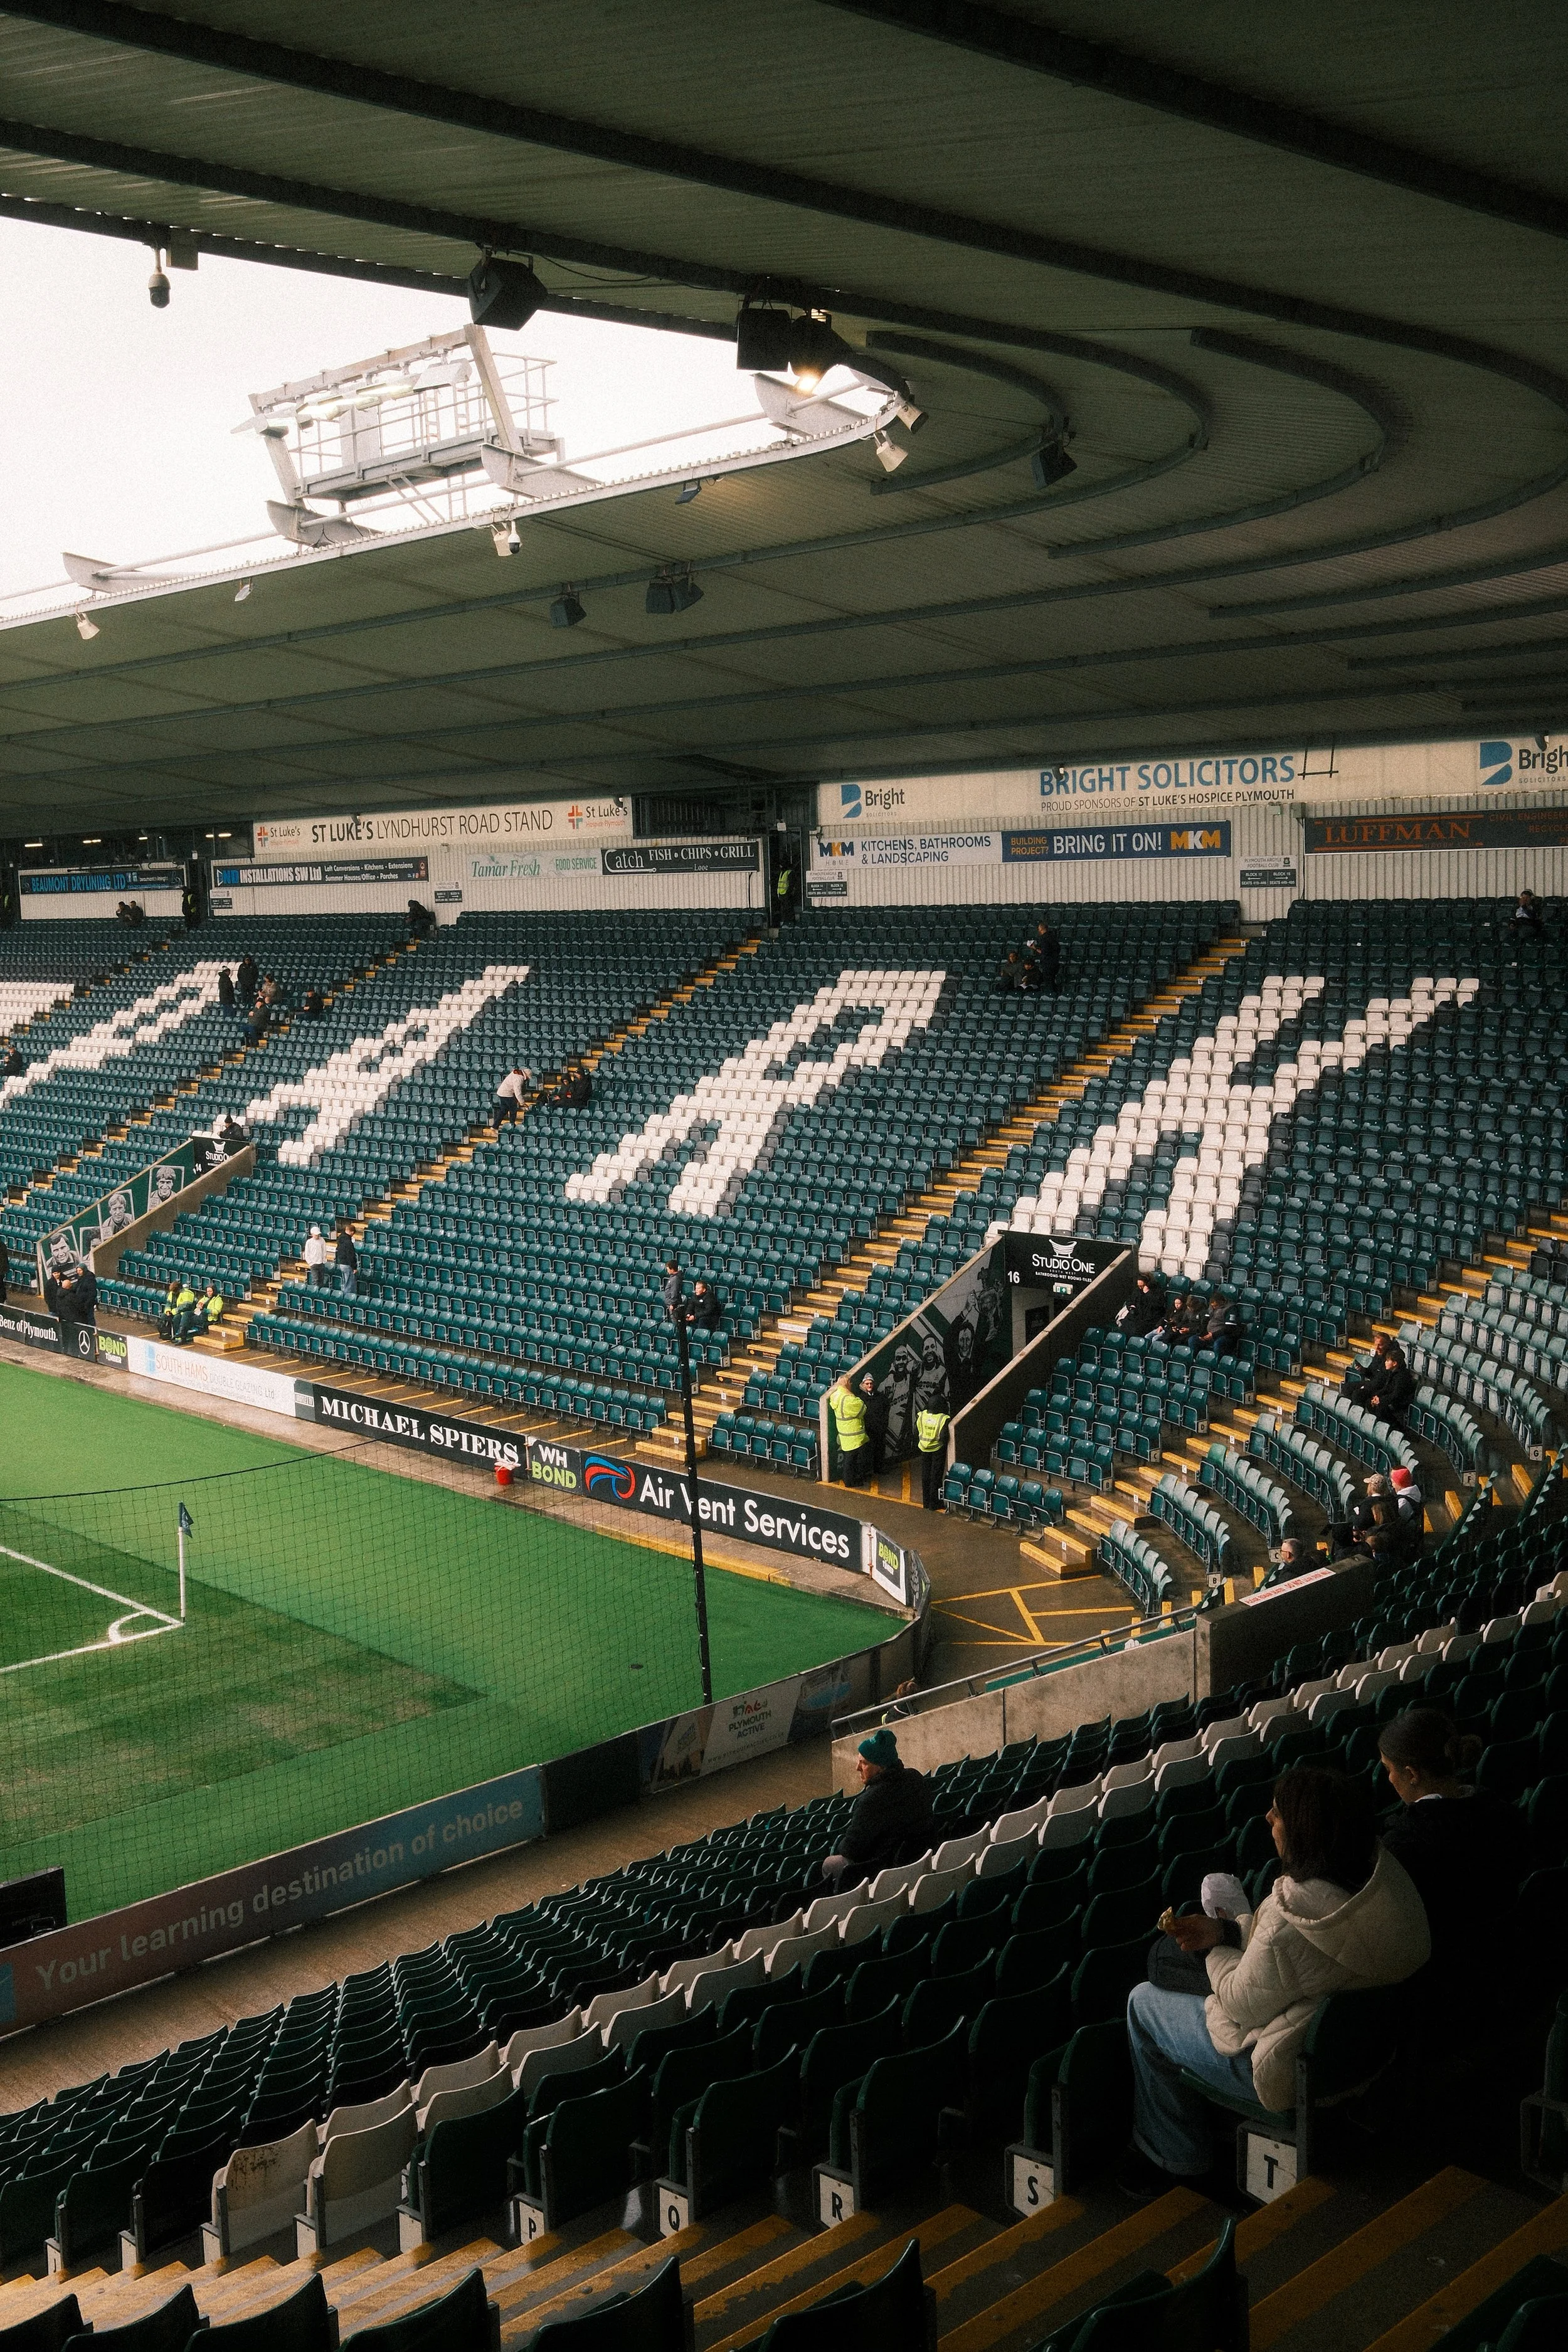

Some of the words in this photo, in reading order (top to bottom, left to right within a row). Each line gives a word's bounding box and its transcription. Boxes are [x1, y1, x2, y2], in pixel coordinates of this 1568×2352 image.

[1040, 766, 1130, 796] BRIGHT
[1138, 755, 1295, 790] SOLICITORS
[866, 788, 905, 810] Bright
[1041, 800, 1072, 812] PROUD
[1074, 797, 1121, 810] SPONSORS
[1123, 797, 1136, 807] OF
[1138, 797, 1150, 807] ST
[1152, 794, 1186, 806] LUKE'S
[1189, 791, 1233, 804] HOSPICE
[1235, 789, 1295, 802] PLYMOUTH
[586, 806, 595, 818] St
[598, 804, 628, 817] Lukes
[270, 827, 277, 838] St
[279, 826, 300, 837] Luke's
[312, 825, 326, 843] ST
[329, 821, 374, 842] LUKE'S
[377, 816, 455, 839] LYNDHURST
[459, 813, 500, 835] ROAD
[504, 810, 553, 832] STAND
[605, 820, 625, 828] Plymouth
[1325, 822, 1471, 844] LUFFMAN
[819, 841, 854, 857] MKM
[861, 839, 917, 851] KITCHENS,
[920, 835, 991, 849] BATHROOMS
[1011, 837, 1047, 845] BUILDING
[1011, 846, 1049, 855] PROJECT?
[1053, 834, 1106, 854] BRING
[1112, 833, 1127, 852] IT
[1132, 832, 1162, 852] ON!
[1170, 830, 1221, 850] MKM
[556, 858, 570, 870] FOOD
[571, 857, 597, 869] SERVICE
[604, 849, 657, 873] Catch
[649, 849, 672, 861] FISH
[681, 847, 712, 860] CHIPS
[721, 845, 755, 858] GRILL
[862, 856, 868, 864] &
[872, 851, 949, 864] LANDSCAPING
[240, 867, 294, 883] INSTALLATIONS
[295, 867, 308, 881] SW
[309, 866, 322, 881] Ltd
[344, 873, 376, 881] Houses/Office
[472, 861, 507, 877] Tamar
[510, 859, 540, 876] Fresh
[31, 876, 68, 892] BEAUMONT
[71, 874, 110, 891] DRYLINING
[113, 872, 125, 889] LTD
[196, 1163, 201, 1172] 14
[1007, 1271, 1020, 1283] 16
[17, 1322, 23, 1332] of
[24, 1322, 58, 1342] Plymouth.
[98, 1335, 127, 1357] BOND
[156, 1355, 183, 1375] SOUTH
[185, 1362, 208, 1382] HAMS
[209, 1373, 234, 1389] DOUBLE
[235, 1380, 263, 1396] GLAZING
[265, 1388, 275, 1399] Ltd
[321, 1396, 425, 1441] MICHAEL
[430, 1424, 519, 1463] SPIERS
[539, 1444, 567, 1468] WH
[532, 1461, 576, 1490] BOND
[640, 1473, 674, 1508] Air
[680, 1481, 736, 1526] Vent
[744, 1499, 850, 1559] Services
[879, 1542, 899, 1570] BOND
[729, 1710, 771, 1732] PLYMOUTH
[737, 1722, 765, 1740] ACTIVE
[36, 1951, 112, 1991] Your
[120, 1900, 245, 1961] learning
[253, 1843, 405, 1914] destination
[411, 1826, 435, 1855] of
[442, 1798, 523, 1843] choice
[1264, 2155, 1278, 2188] T
[1027, 2176, 1039, 2205] S
[668, 2205, 680, 2230] Q
[832, 2191, 842, 2222] R
